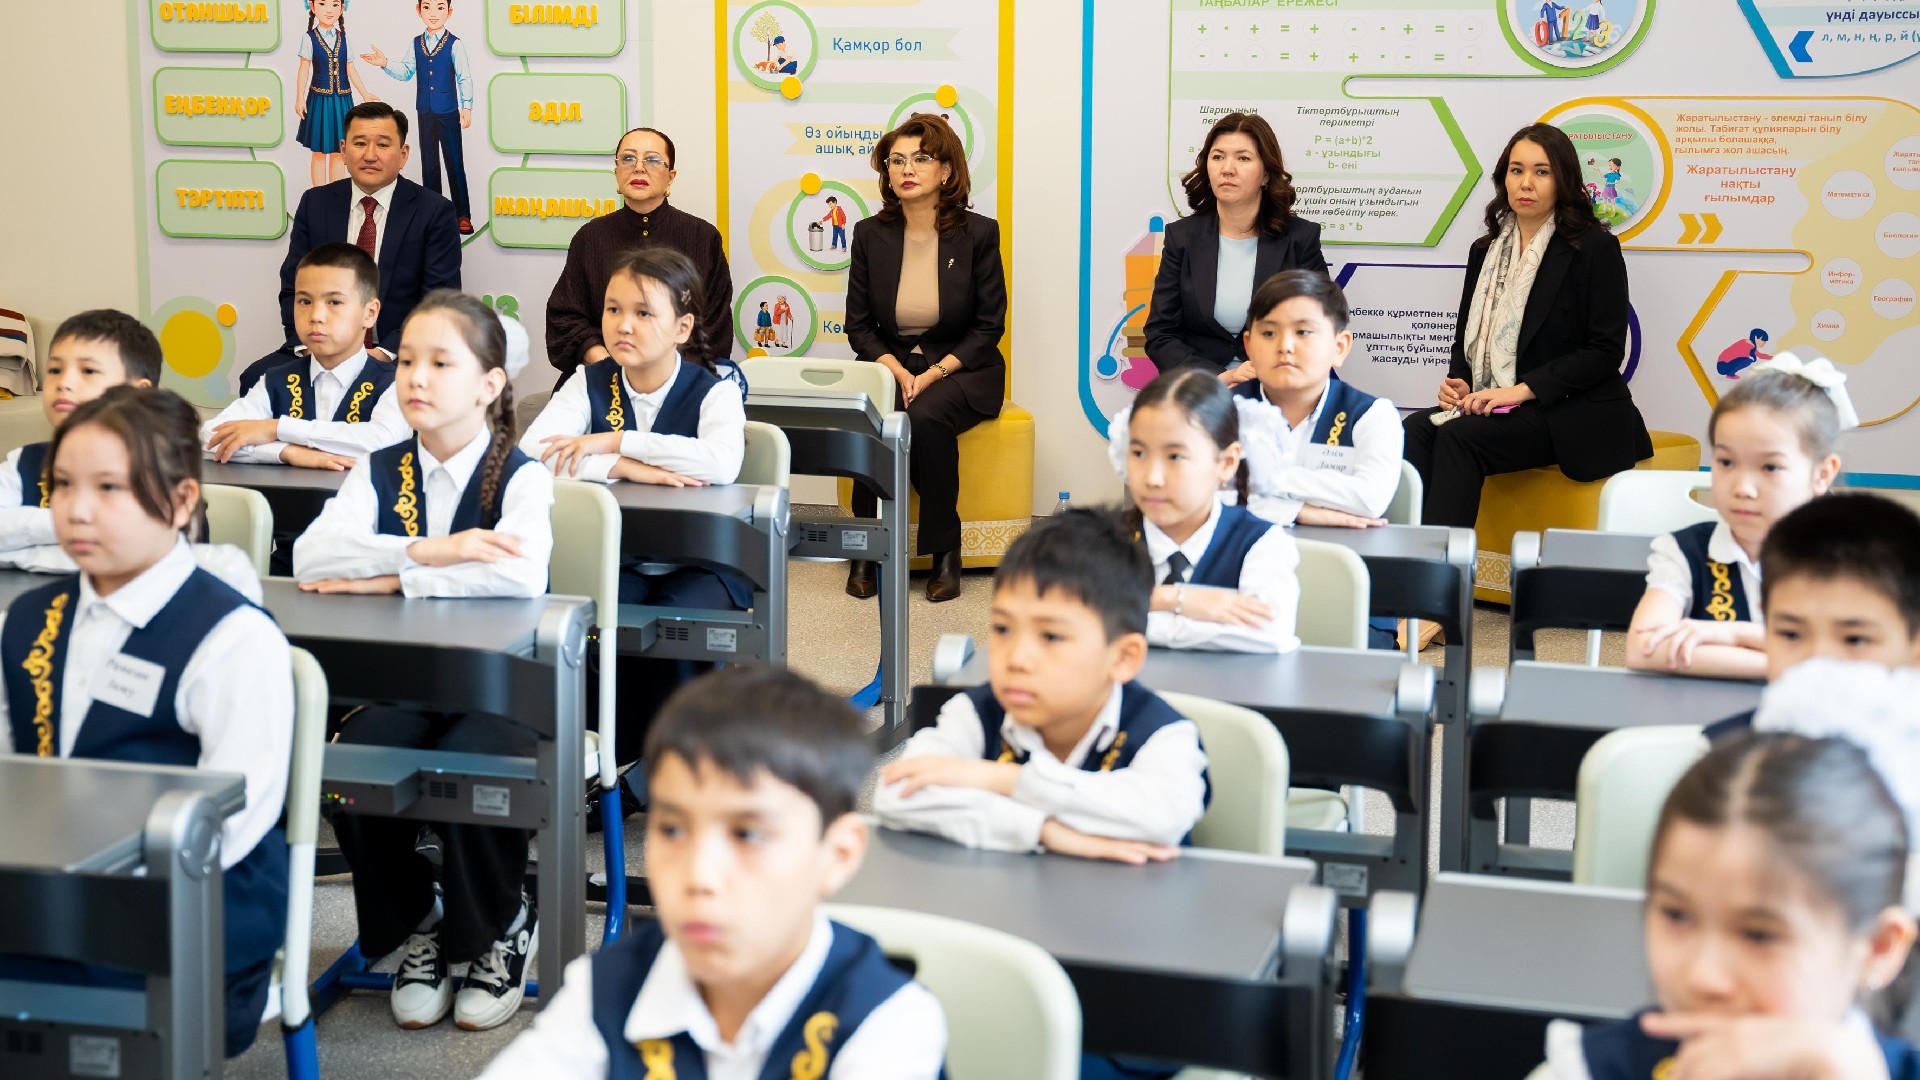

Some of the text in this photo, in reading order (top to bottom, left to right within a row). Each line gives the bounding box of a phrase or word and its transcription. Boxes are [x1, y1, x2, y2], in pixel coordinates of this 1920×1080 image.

[160, 2, 268, 22] ОТАНШЫЛ
[509, 4, 598, 28] БІЛІМДІ
[1826, 9, 1855, 22] үнді
[833, 37, 922, 54] Қамқор бол
[164, 95, 271, 119] ЕҢБЕКҚОР
[1297, 106, 1400, 117] Тіктөртбұрыштың
[528, 101, 583, 125] ӘДІЛ
[1676, 113, 1762, 124] Жаратылыстану
[1809, 114, 1842, 122] танып
[1845, 113, 1868, 124] білу
[1320, 119, 1375, 129] периметрі
[1819, 125, 1842, 134] білу
[805, 125, 883, 141] Өз ойыңды
[1675, 136, 1717, 145] арқылы
[815, 144, 855, 156] ашық
[1321, 149, 1381, 158] ұзындығы
[1686, 164, 1797, 177] Жаратылыстану
[1720, 180, 1761, 190] нақты
[1378, 187, 1422, 197] ауданын
[175, 187, 265, 210] ТӘРТІПТІ
[1329, 198, 1357, 207] оның
[1704, 194, 1776, 205] ғылымдар
[493, 195, 617, 220] ЖАҢАШЫЛ
[1322, 206, 1367, 218] көбейту
[1368, 209, 1399, 219] керек.
[1873, 295, 1913, 303] География
[1387, 309, 1443, 319] құрметпен
[1366, 343, 1453, 355] ұлттық бұйымд
[1371, 355, 1420, 366] жасауды
